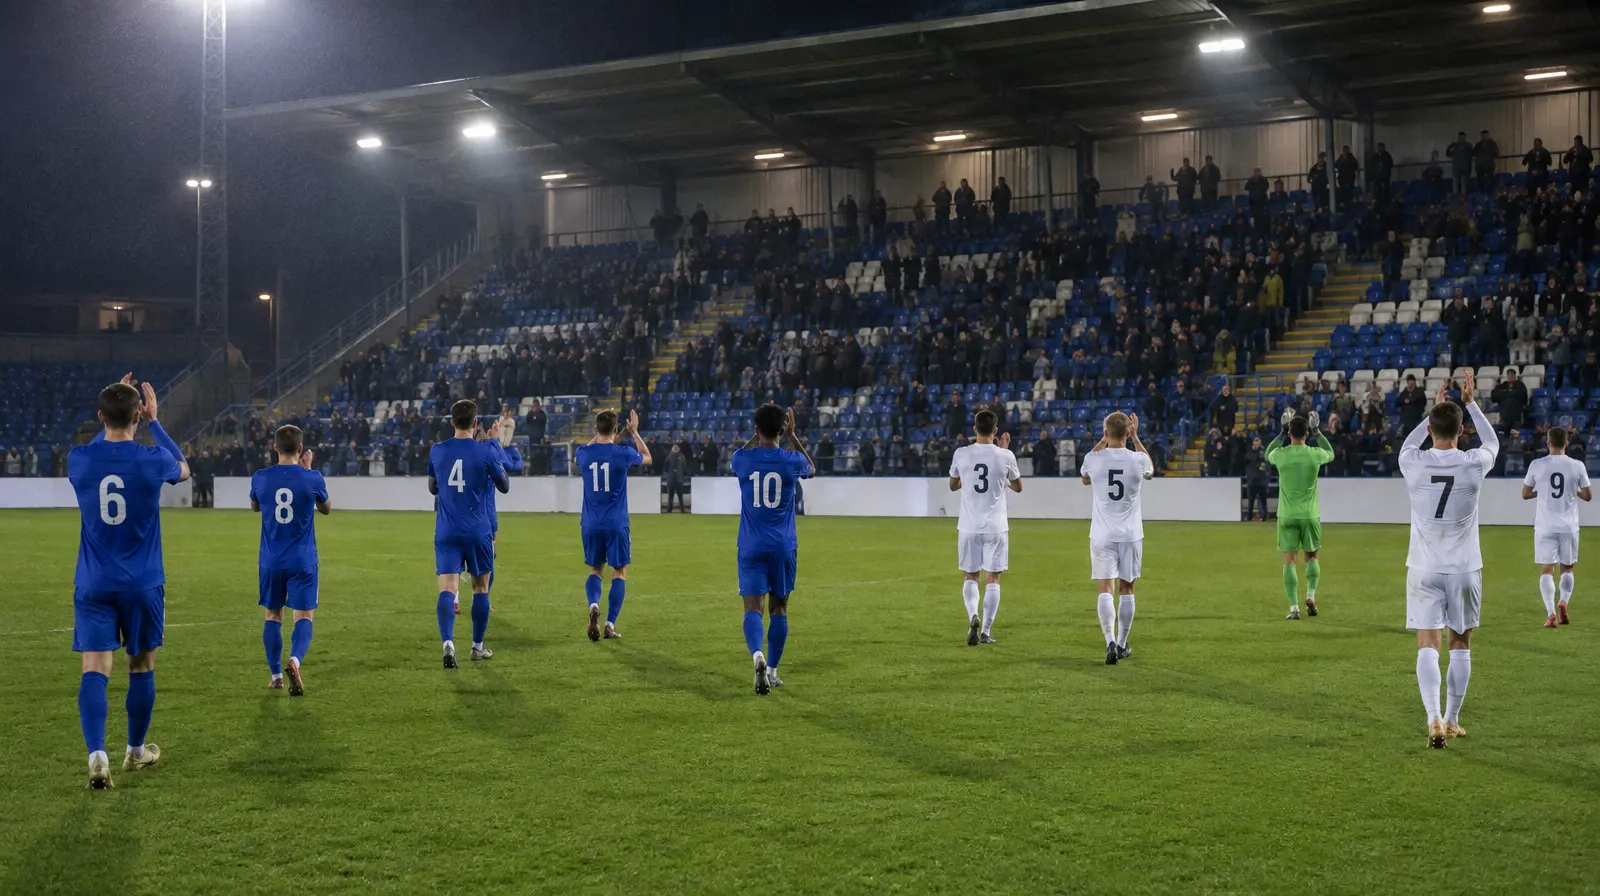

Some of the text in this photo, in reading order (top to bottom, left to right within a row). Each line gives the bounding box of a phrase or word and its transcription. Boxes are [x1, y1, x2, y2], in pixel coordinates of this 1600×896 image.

[448, 459, 466, 492] 4
[589, 462, 609, 492] 11
[749, 472, 782, 508] 10
[974, 464, 988, 493] 3
[1108, 469, 1124, 501] 5
[1550, 472, 1564, 499] 9
[100, 475, 127, 525] 6
[275, 488, 294, 523] 8
[1431, 476, 1454, 518] 7
